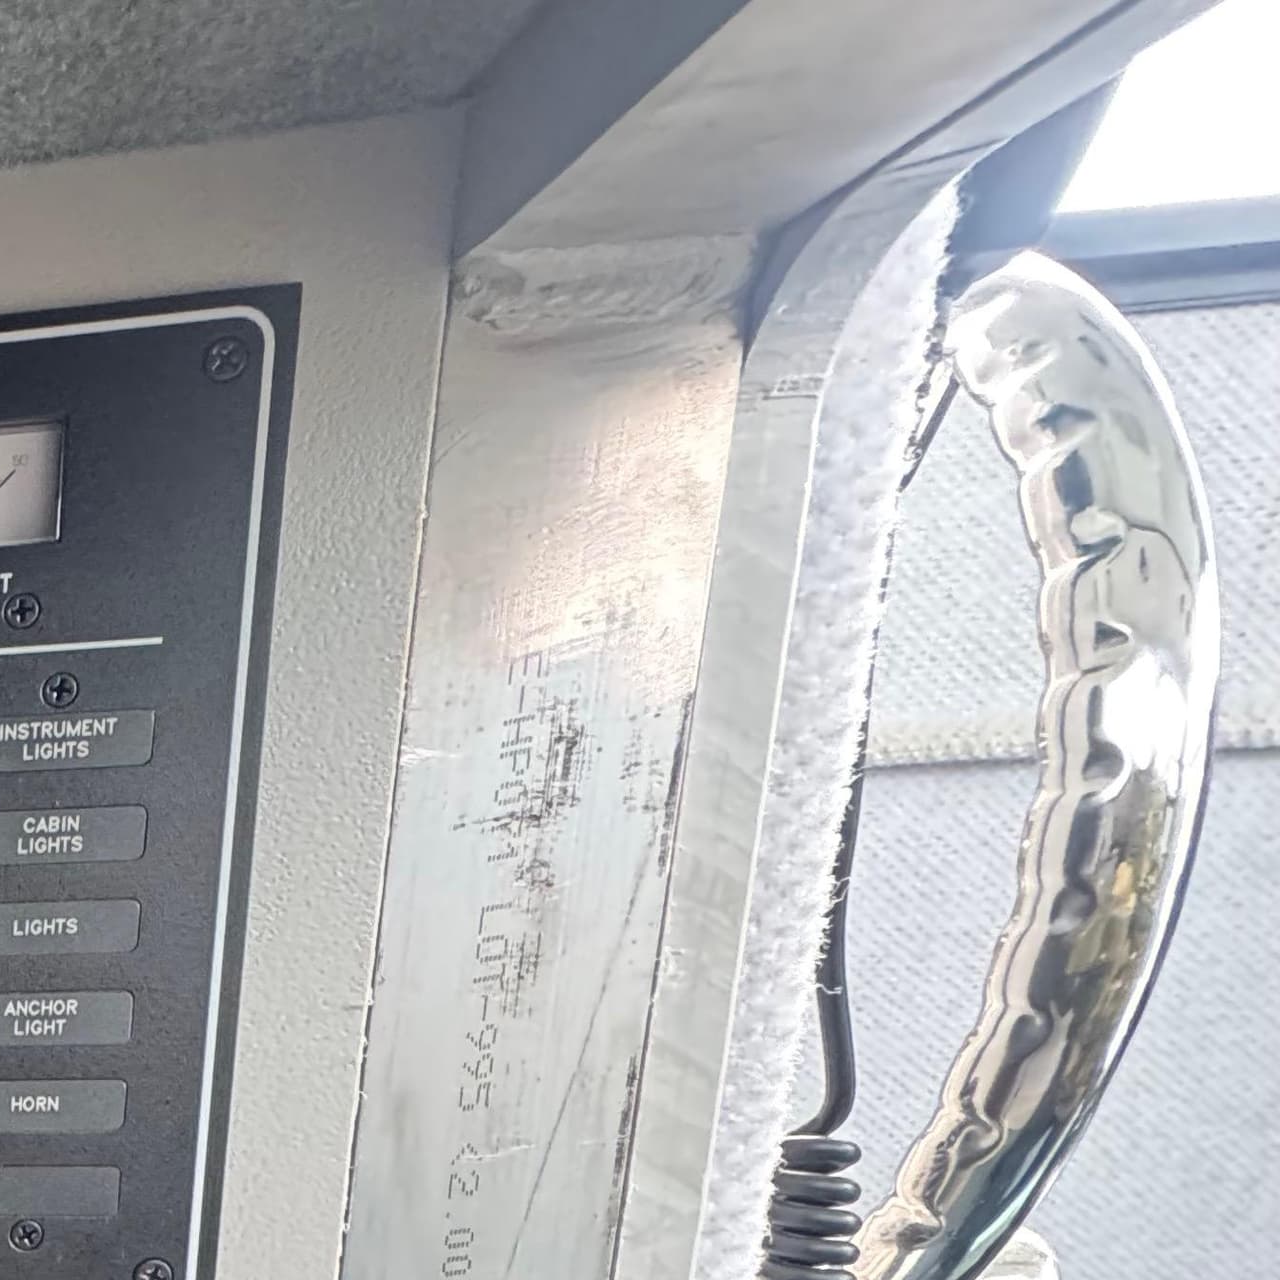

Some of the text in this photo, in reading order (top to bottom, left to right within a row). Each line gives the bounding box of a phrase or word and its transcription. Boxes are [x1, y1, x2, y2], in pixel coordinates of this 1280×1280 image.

[22, 740, 90, 762] LIGHTS
[22, 815, 81, 835] CABIN
[17, 835, 84, 856] LIGHTS
[12, 917, 79, 937] LIGHTS
[3, 998, 79, 1018] ANCHOR
[13, 1018, 67, 1037] LIGHT
[10, 1095, 60, 1113] HORN
